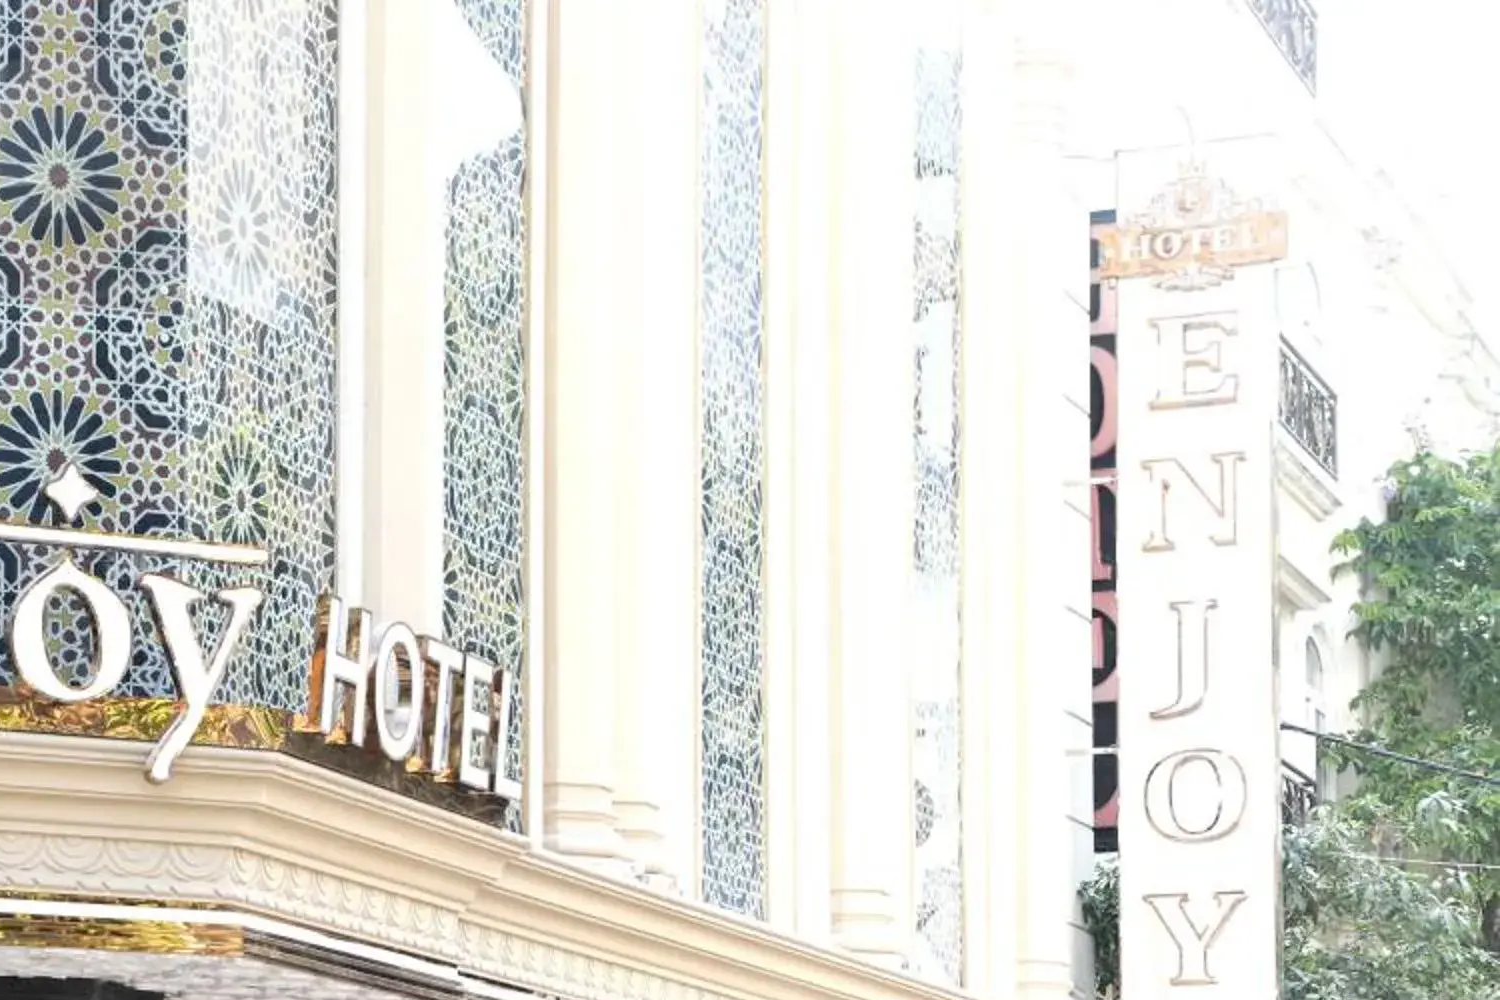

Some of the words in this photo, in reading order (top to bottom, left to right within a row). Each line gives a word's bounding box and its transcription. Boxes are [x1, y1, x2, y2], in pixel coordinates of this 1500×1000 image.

[1120, 221, 1268, 262] HOTEL
[320, 596, 522, 800] HOTEL
[1141, 309, 1248, 987] ENJOY
